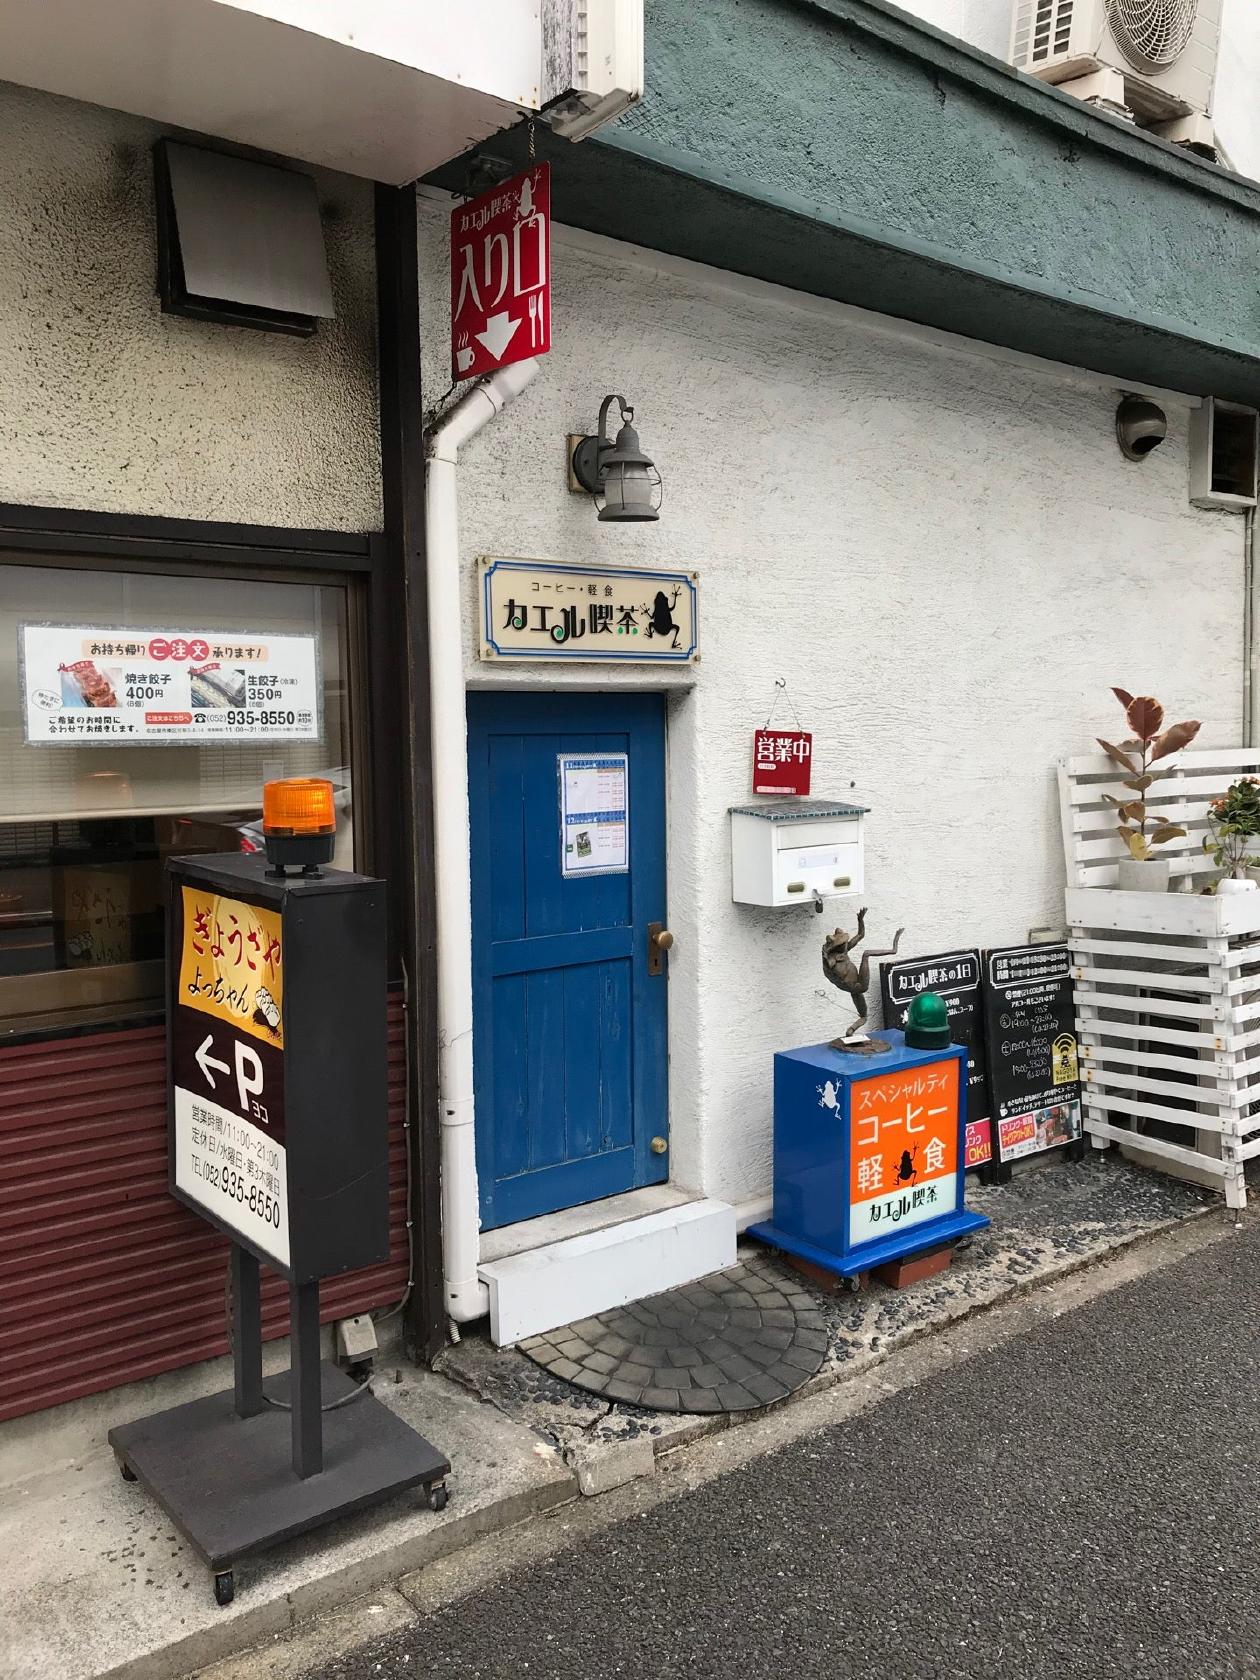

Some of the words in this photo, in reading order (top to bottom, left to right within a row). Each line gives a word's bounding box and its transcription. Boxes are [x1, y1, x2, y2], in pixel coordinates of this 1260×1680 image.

[460, 192, 512, 233] カエル喫茶
[454, 213, 546, 322] 入り口
[502, 599, 639, 643] カエル喫茶
[125, 673, 171, 685] 焼き餃子
[126, 687, 163, 699] 400円
[248, 689, 282, 700] 350円
[49, 716, 121, 724] ご希望のお時間に
[757, 737, 810, 763] 営業中
[192, 904, 281, 983] ぎょうざや
[188, 966, 249, 1013] よっちゃん
[235, 1039, 264, 1112] P
[858, 1073, 949, 1110] スペシャルティ
[252, 1100, 269, 1124] ヨコ
[858, 1103, 948, 1146] コーヒー
[869, 1185, 938, 1223] カエル喫茶
